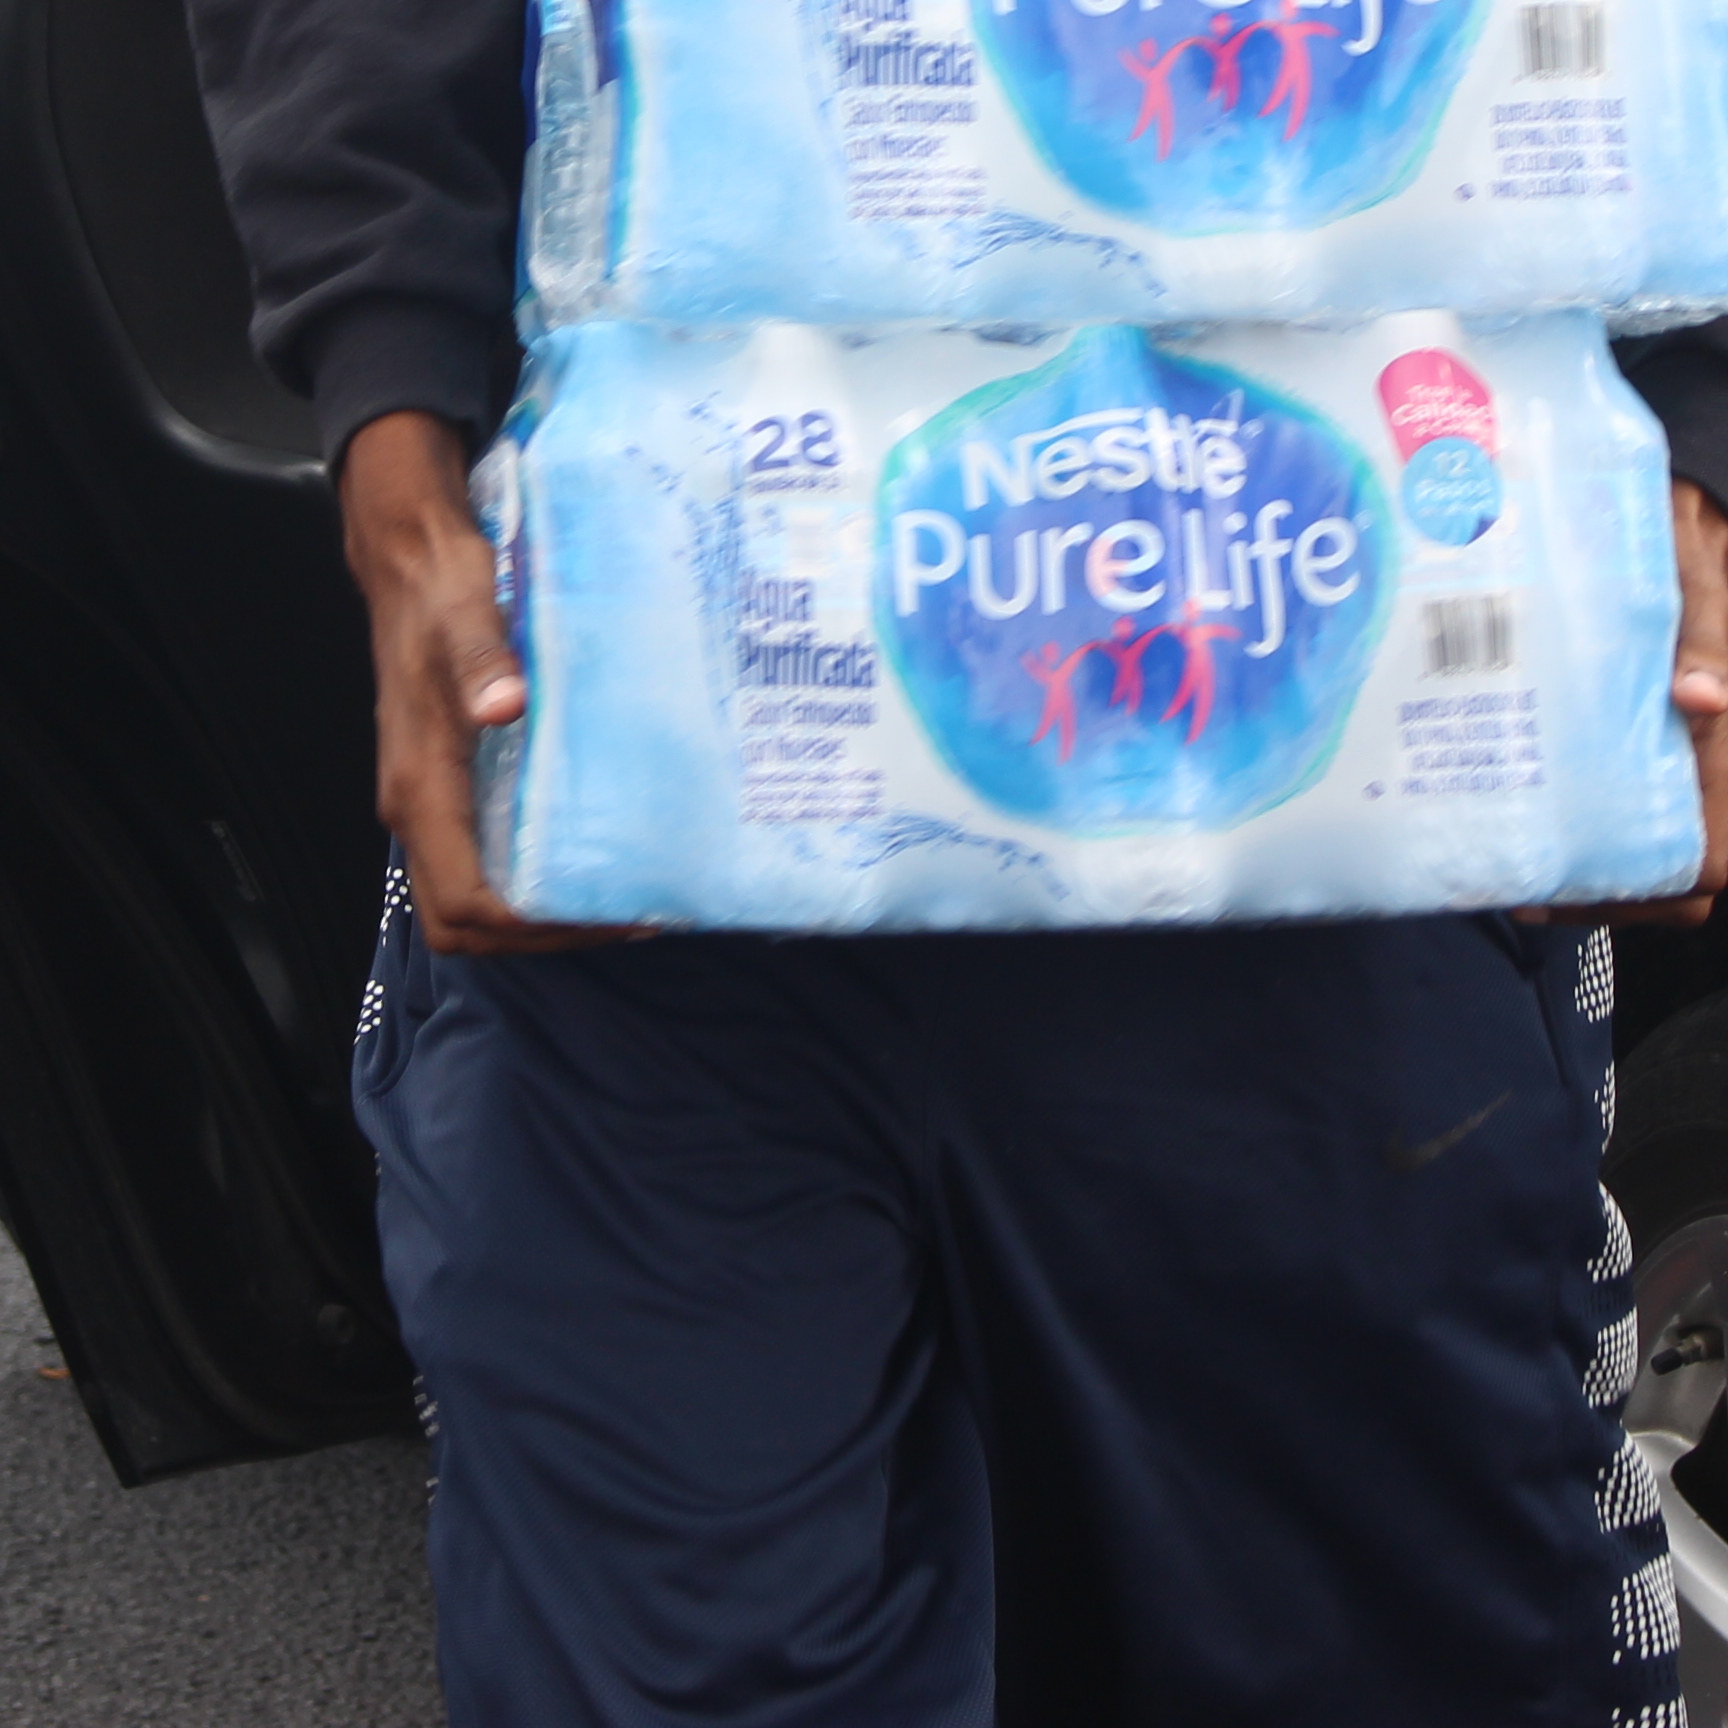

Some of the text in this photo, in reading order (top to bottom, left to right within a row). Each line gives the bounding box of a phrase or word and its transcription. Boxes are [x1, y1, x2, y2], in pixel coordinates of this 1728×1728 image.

[751, 410, 840, 473] 28
[961, 398, 1250, 512] Nestlé
[1433, 450, 1472, 478] 12
[892, 498, 1361, 658] Pure Life
